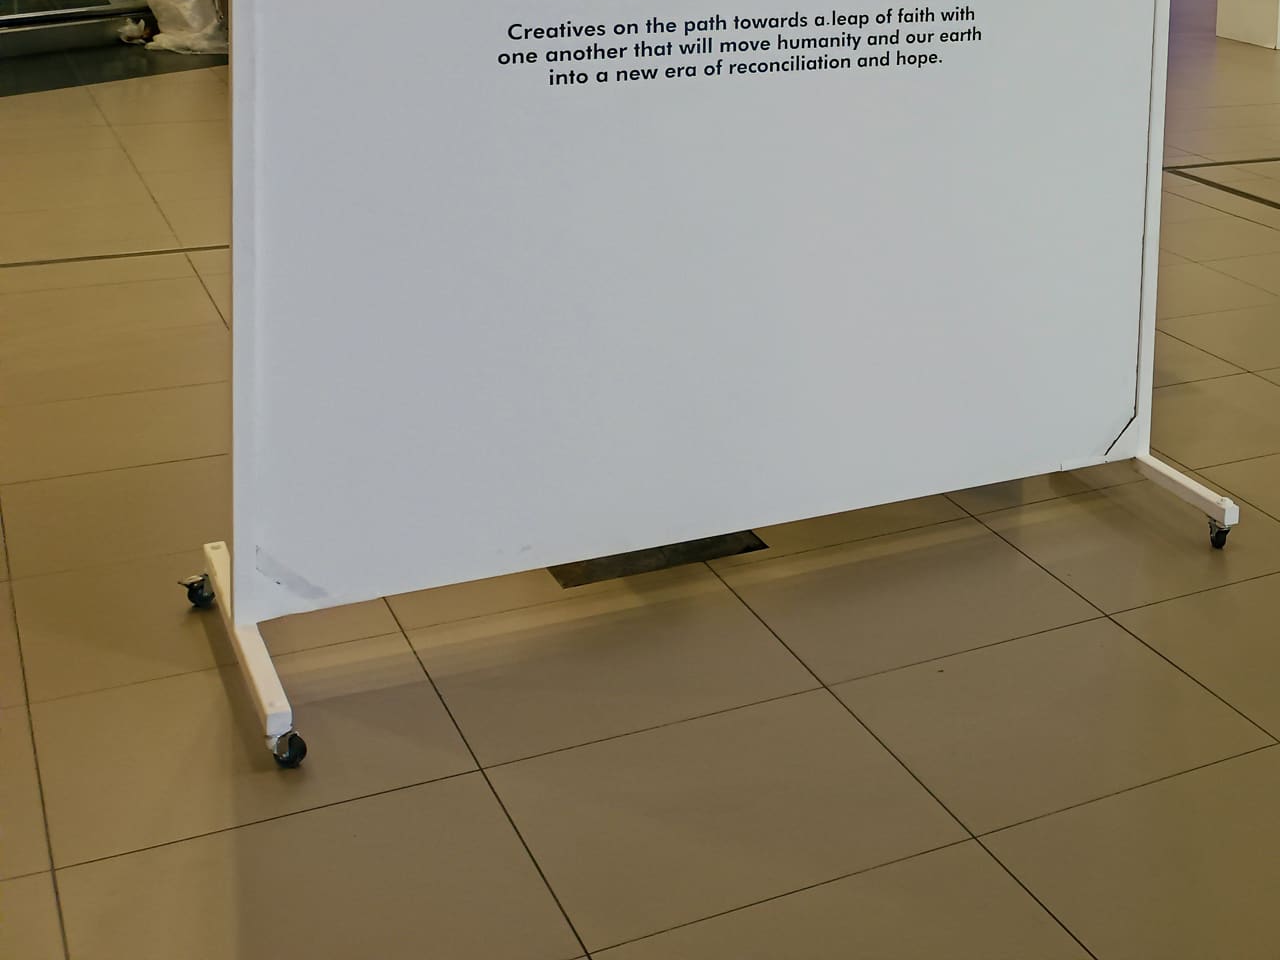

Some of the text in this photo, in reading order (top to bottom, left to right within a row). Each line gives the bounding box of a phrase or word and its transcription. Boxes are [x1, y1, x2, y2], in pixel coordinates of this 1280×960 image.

[507, 20, 606, 41] Creatives
[613, 23, 639, 36] on
[645, 16, 677, 34] the
[684, 13, 727, 37] path
[733, 11, 808, 30] towards
[875, 7, 893, 25] of
[897, 6, 935, 24] faith
[940, 5, 975, 22] with
[497, 25, 982, 65] one another that will move humanity and our earth
[549, 49, 943, 86] into a new era of reconciliation and hope.
